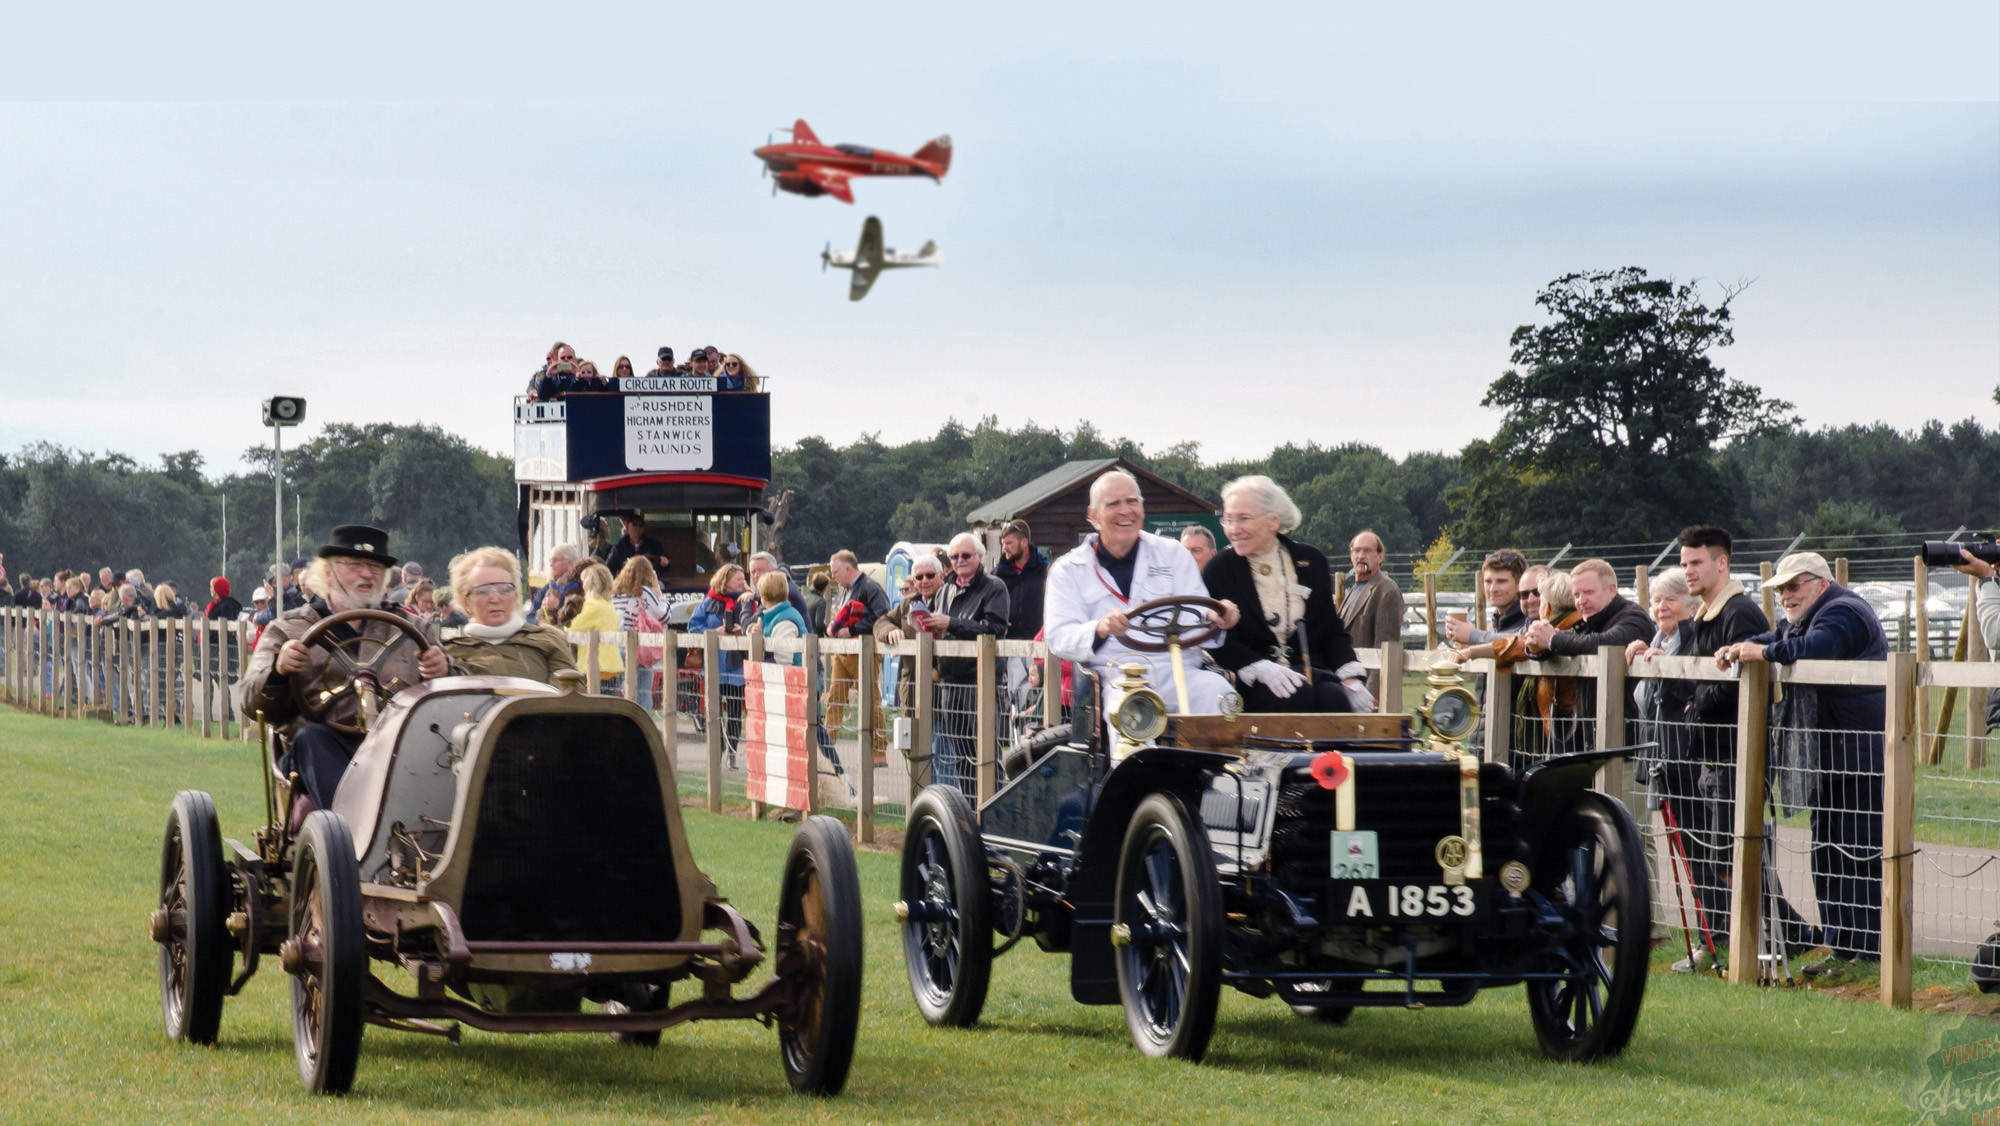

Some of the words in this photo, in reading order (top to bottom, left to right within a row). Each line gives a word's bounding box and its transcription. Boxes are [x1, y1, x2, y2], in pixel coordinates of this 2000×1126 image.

[625, 379, 676, 391] CIRCULAR
[680, 379, 713, 390] ROUTE
[642, 401, 703, 411] RUSHDEN
[666, 416, 711, 426] FERRERS
[637, 430, 702, 440] STANWICK
[639, 444, 702, 455] RAUNDS
[1346, 885, 1374, 917] A
[1388, 885, 1476, 917] 1853
